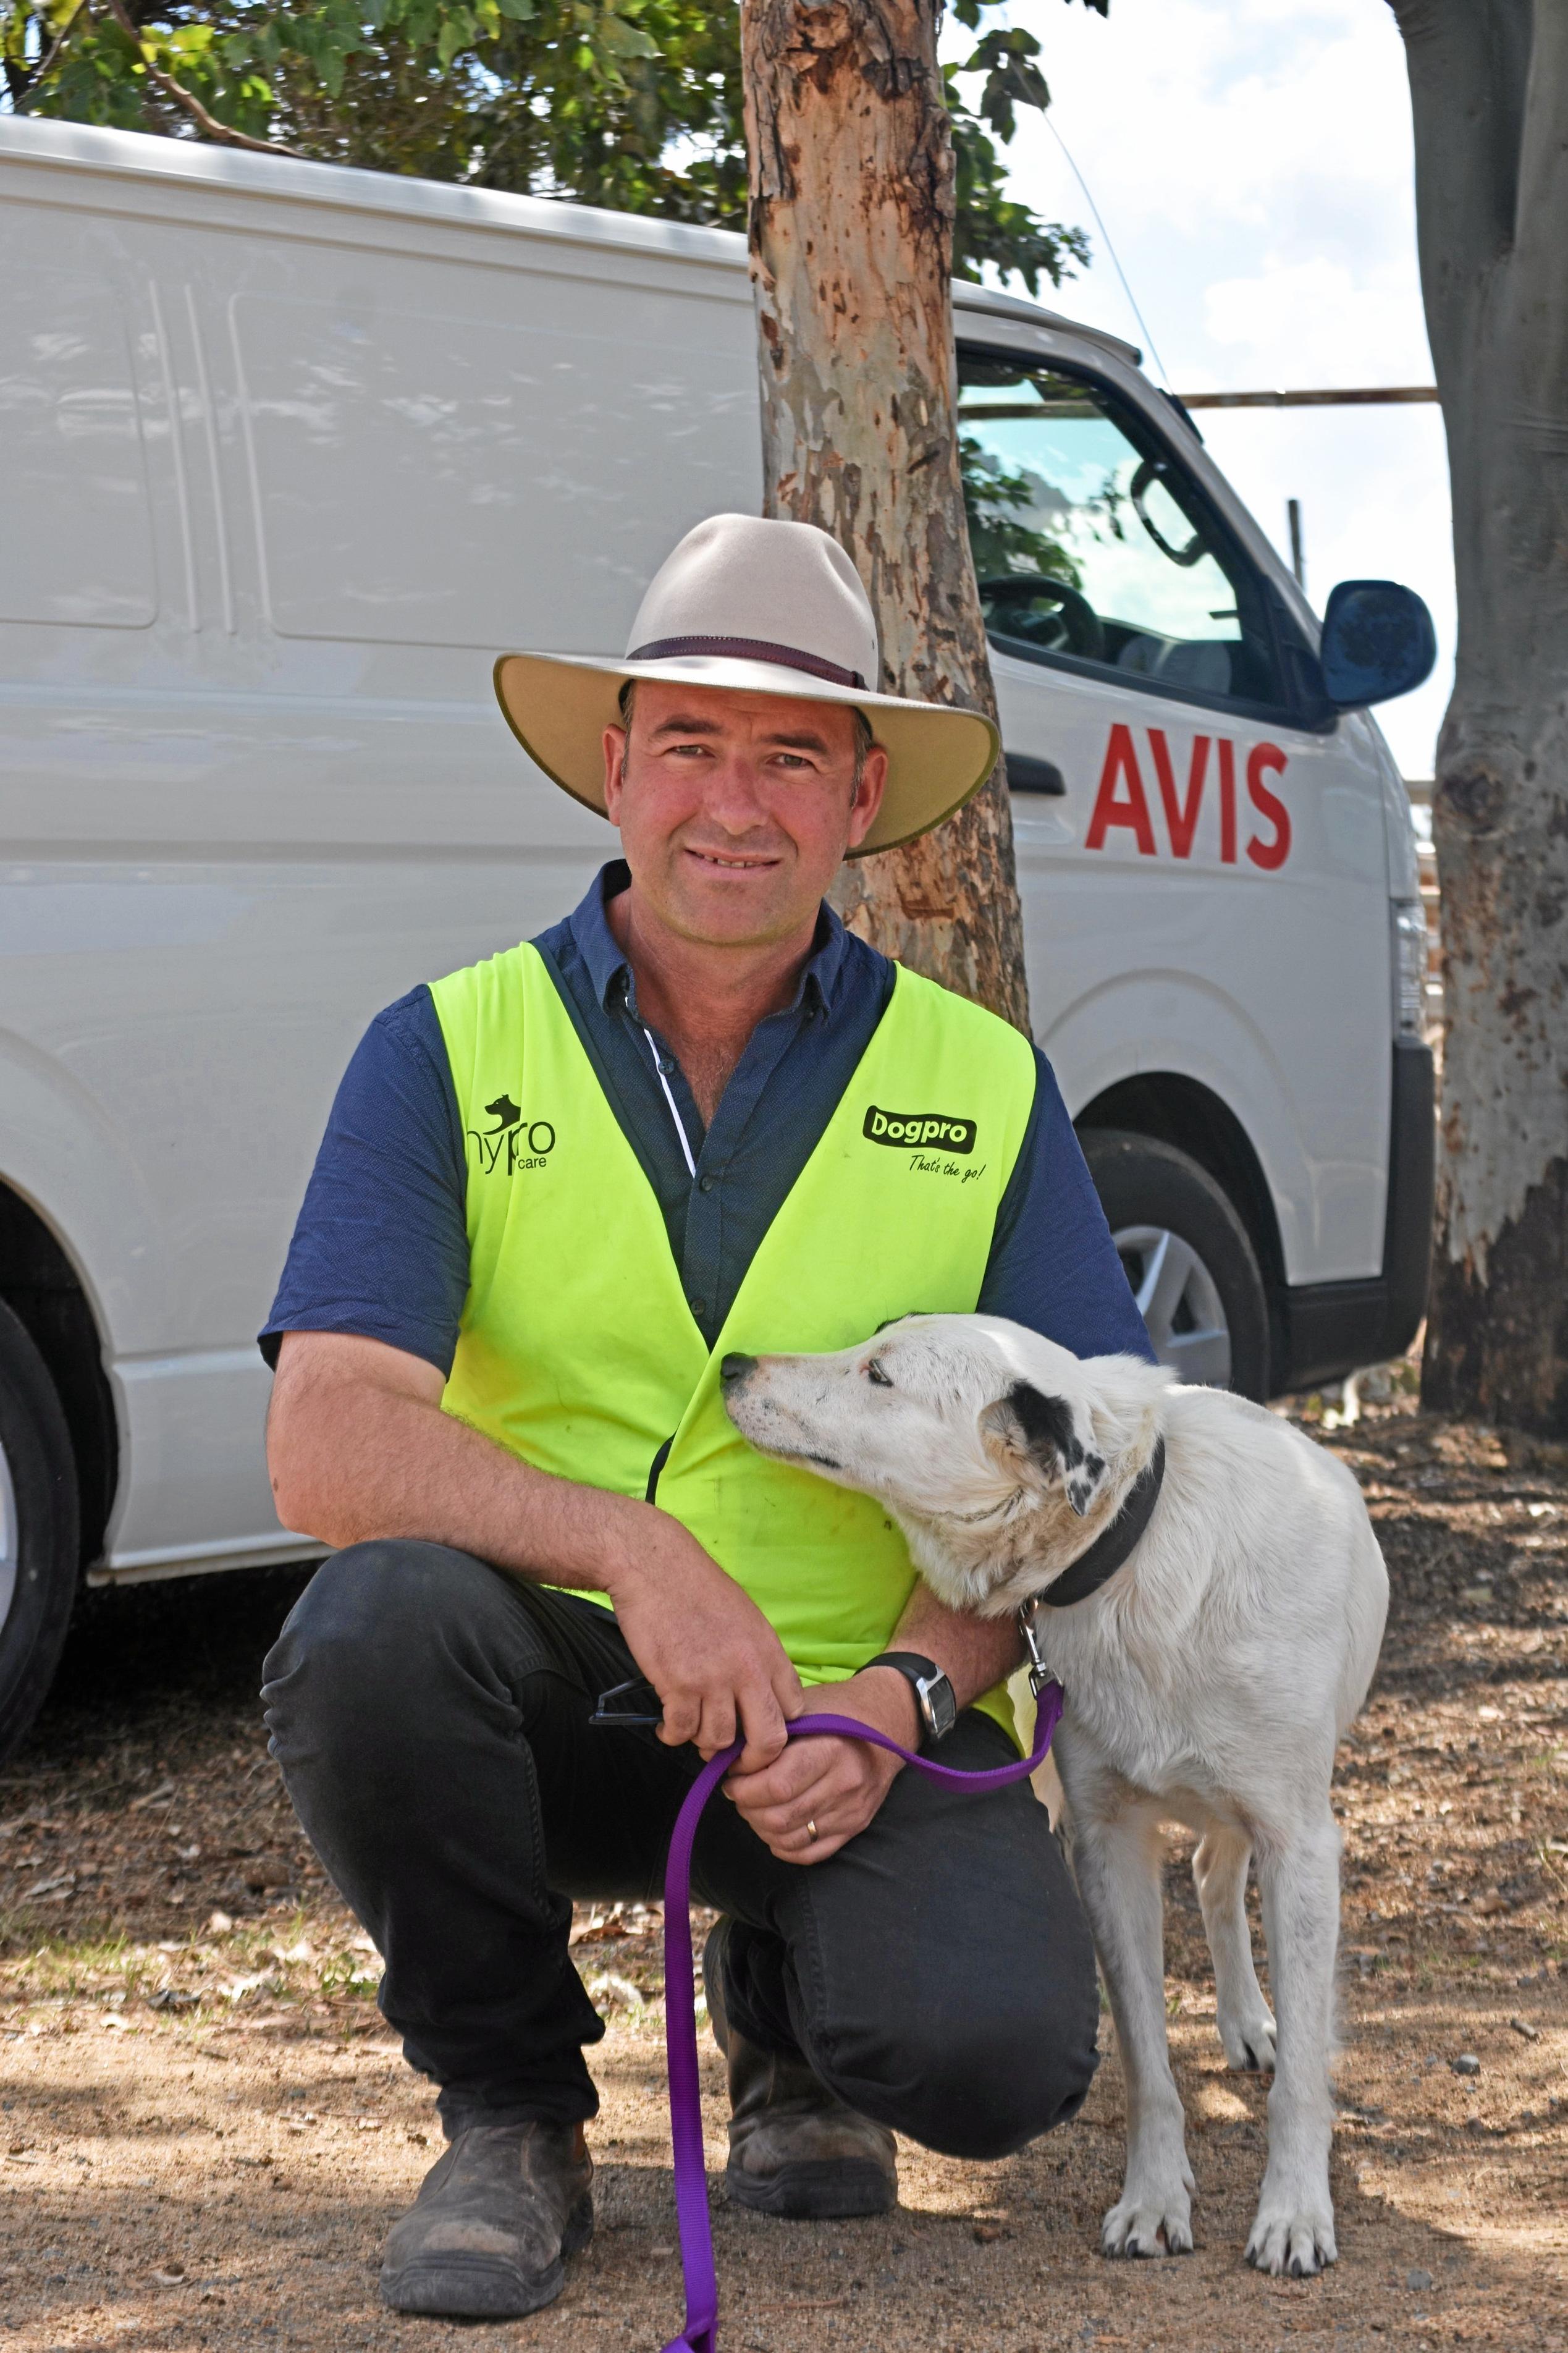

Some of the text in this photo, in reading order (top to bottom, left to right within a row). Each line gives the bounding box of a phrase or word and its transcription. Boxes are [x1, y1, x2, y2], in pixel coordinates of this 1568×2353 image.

[1084, 722, 1292, 872] AVIS
[871, 1112, 967, 1144] Dogpro
[518, 1157, 547, 1170] care
[909, 1154, 987, 1184] That's the go!
